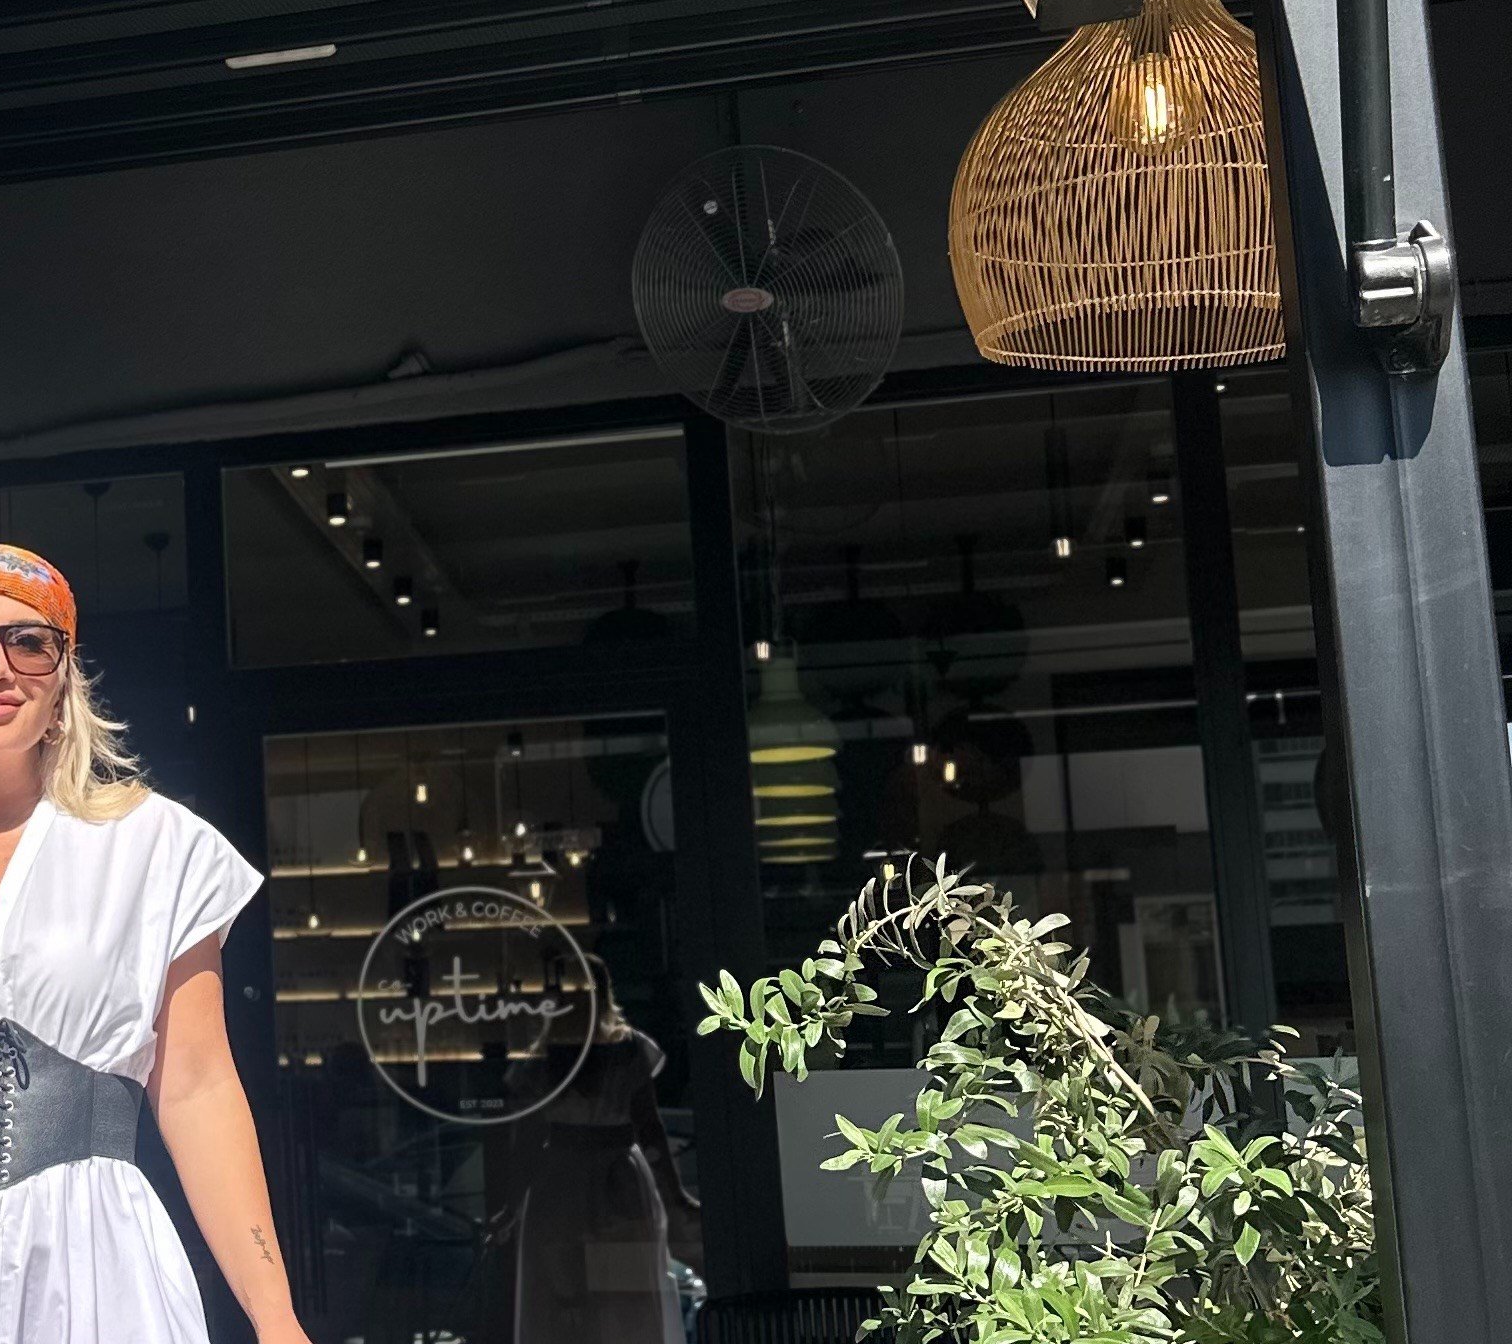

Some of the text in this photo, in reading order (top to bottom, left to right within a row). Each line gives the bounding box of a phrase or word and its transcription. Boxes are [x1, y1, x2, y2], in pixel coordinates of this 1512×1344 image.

[394, 901, 544, 946] WORK & COFFEE
[380, 956, 575, 1087] uptime
